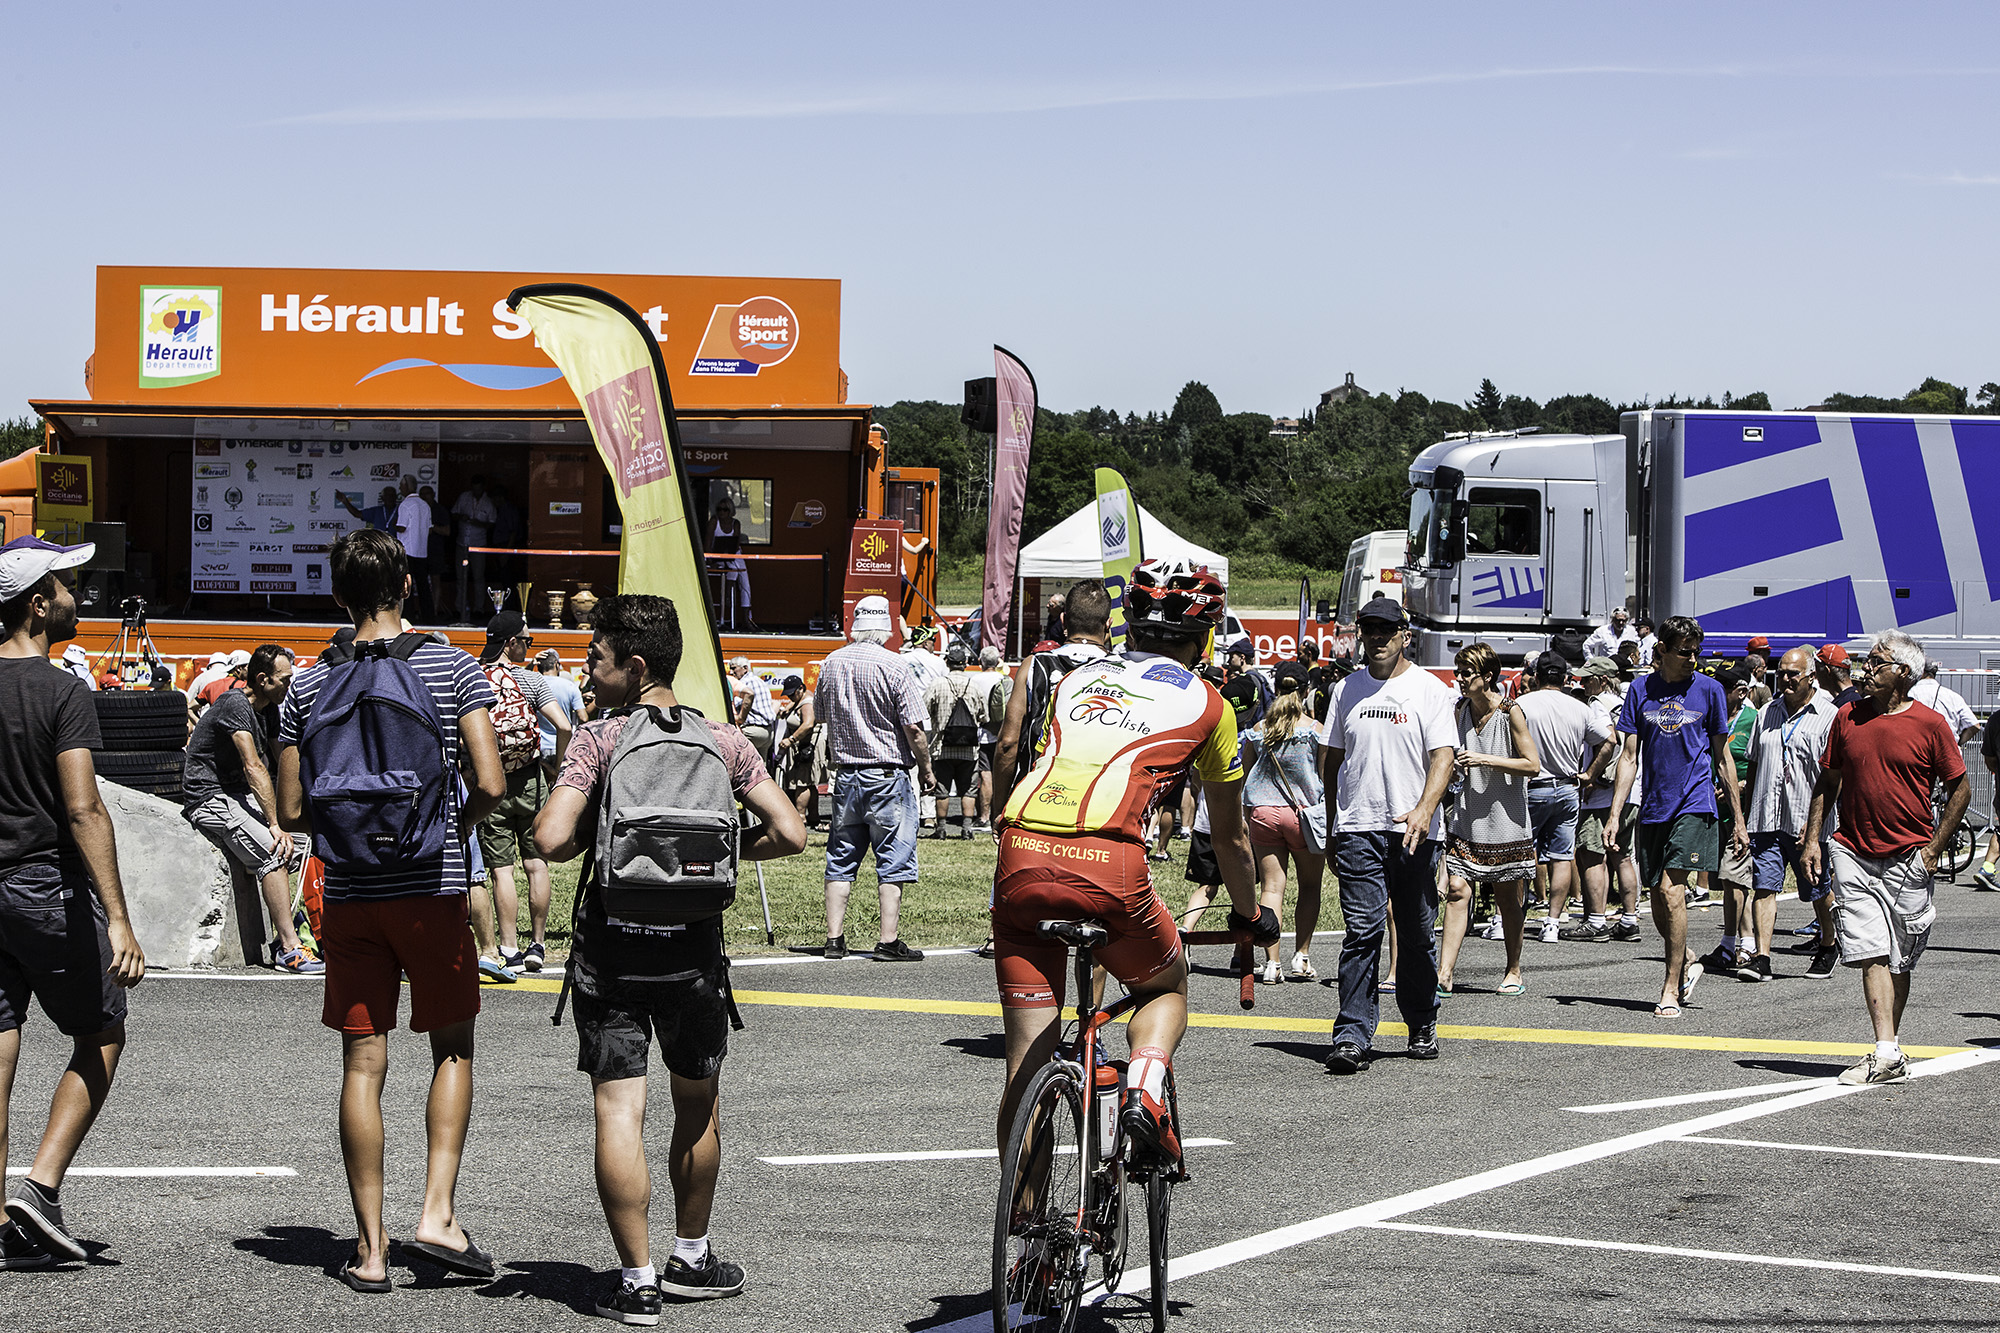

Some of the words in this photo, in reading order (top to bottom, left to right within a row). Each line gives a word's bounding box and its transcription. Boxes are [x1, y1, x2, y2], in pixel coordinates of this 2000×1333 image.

[261, 293, 465, 336] Hérault
[738, 314, 789, 328] Hérault
[738, 326, 789, 344] Sport
[695, 450, 729, 462] Sport
[47, 491, 83, 500] Occitanie
[320, 521, 346, 530] MICHEL
[855, 561, 892, 569] Occitanie
[1181, 591, 1214, 605] MET
[1151, 672, 1182, 685] TARBES
[1080, 686, 1126, 699] TARBES
[1011, 835, 1051, 854] TARBES
[1052, 844, 1110, 863] CYCLISTE
